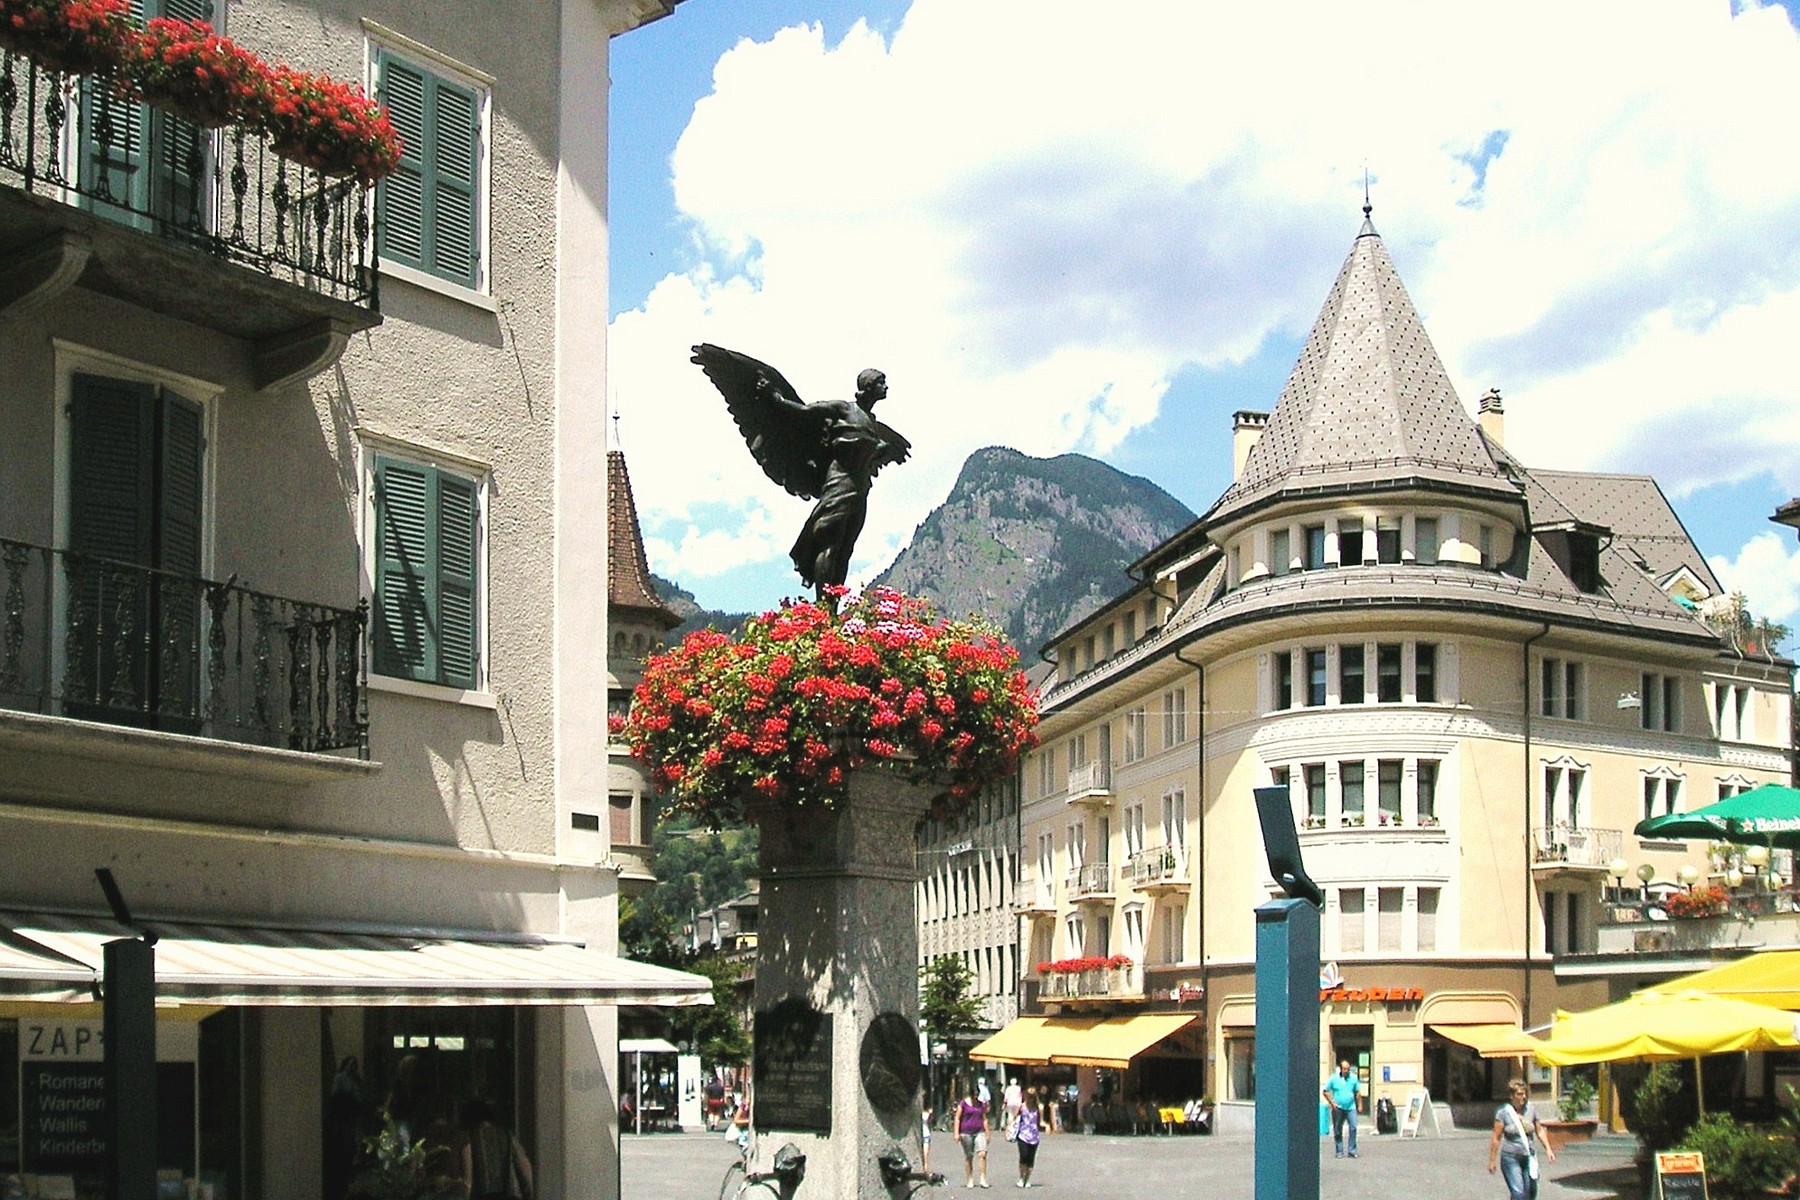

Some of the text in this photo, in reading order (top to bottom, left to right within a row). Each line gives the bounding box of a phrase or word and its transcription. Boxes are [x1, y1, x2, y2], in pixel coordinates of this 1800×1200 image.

[1320, 986, 1424, 1002] rzuben
[39, 1116, 87, 1133] Wallis
[39, 1139, 105, 1154] Kinderb
